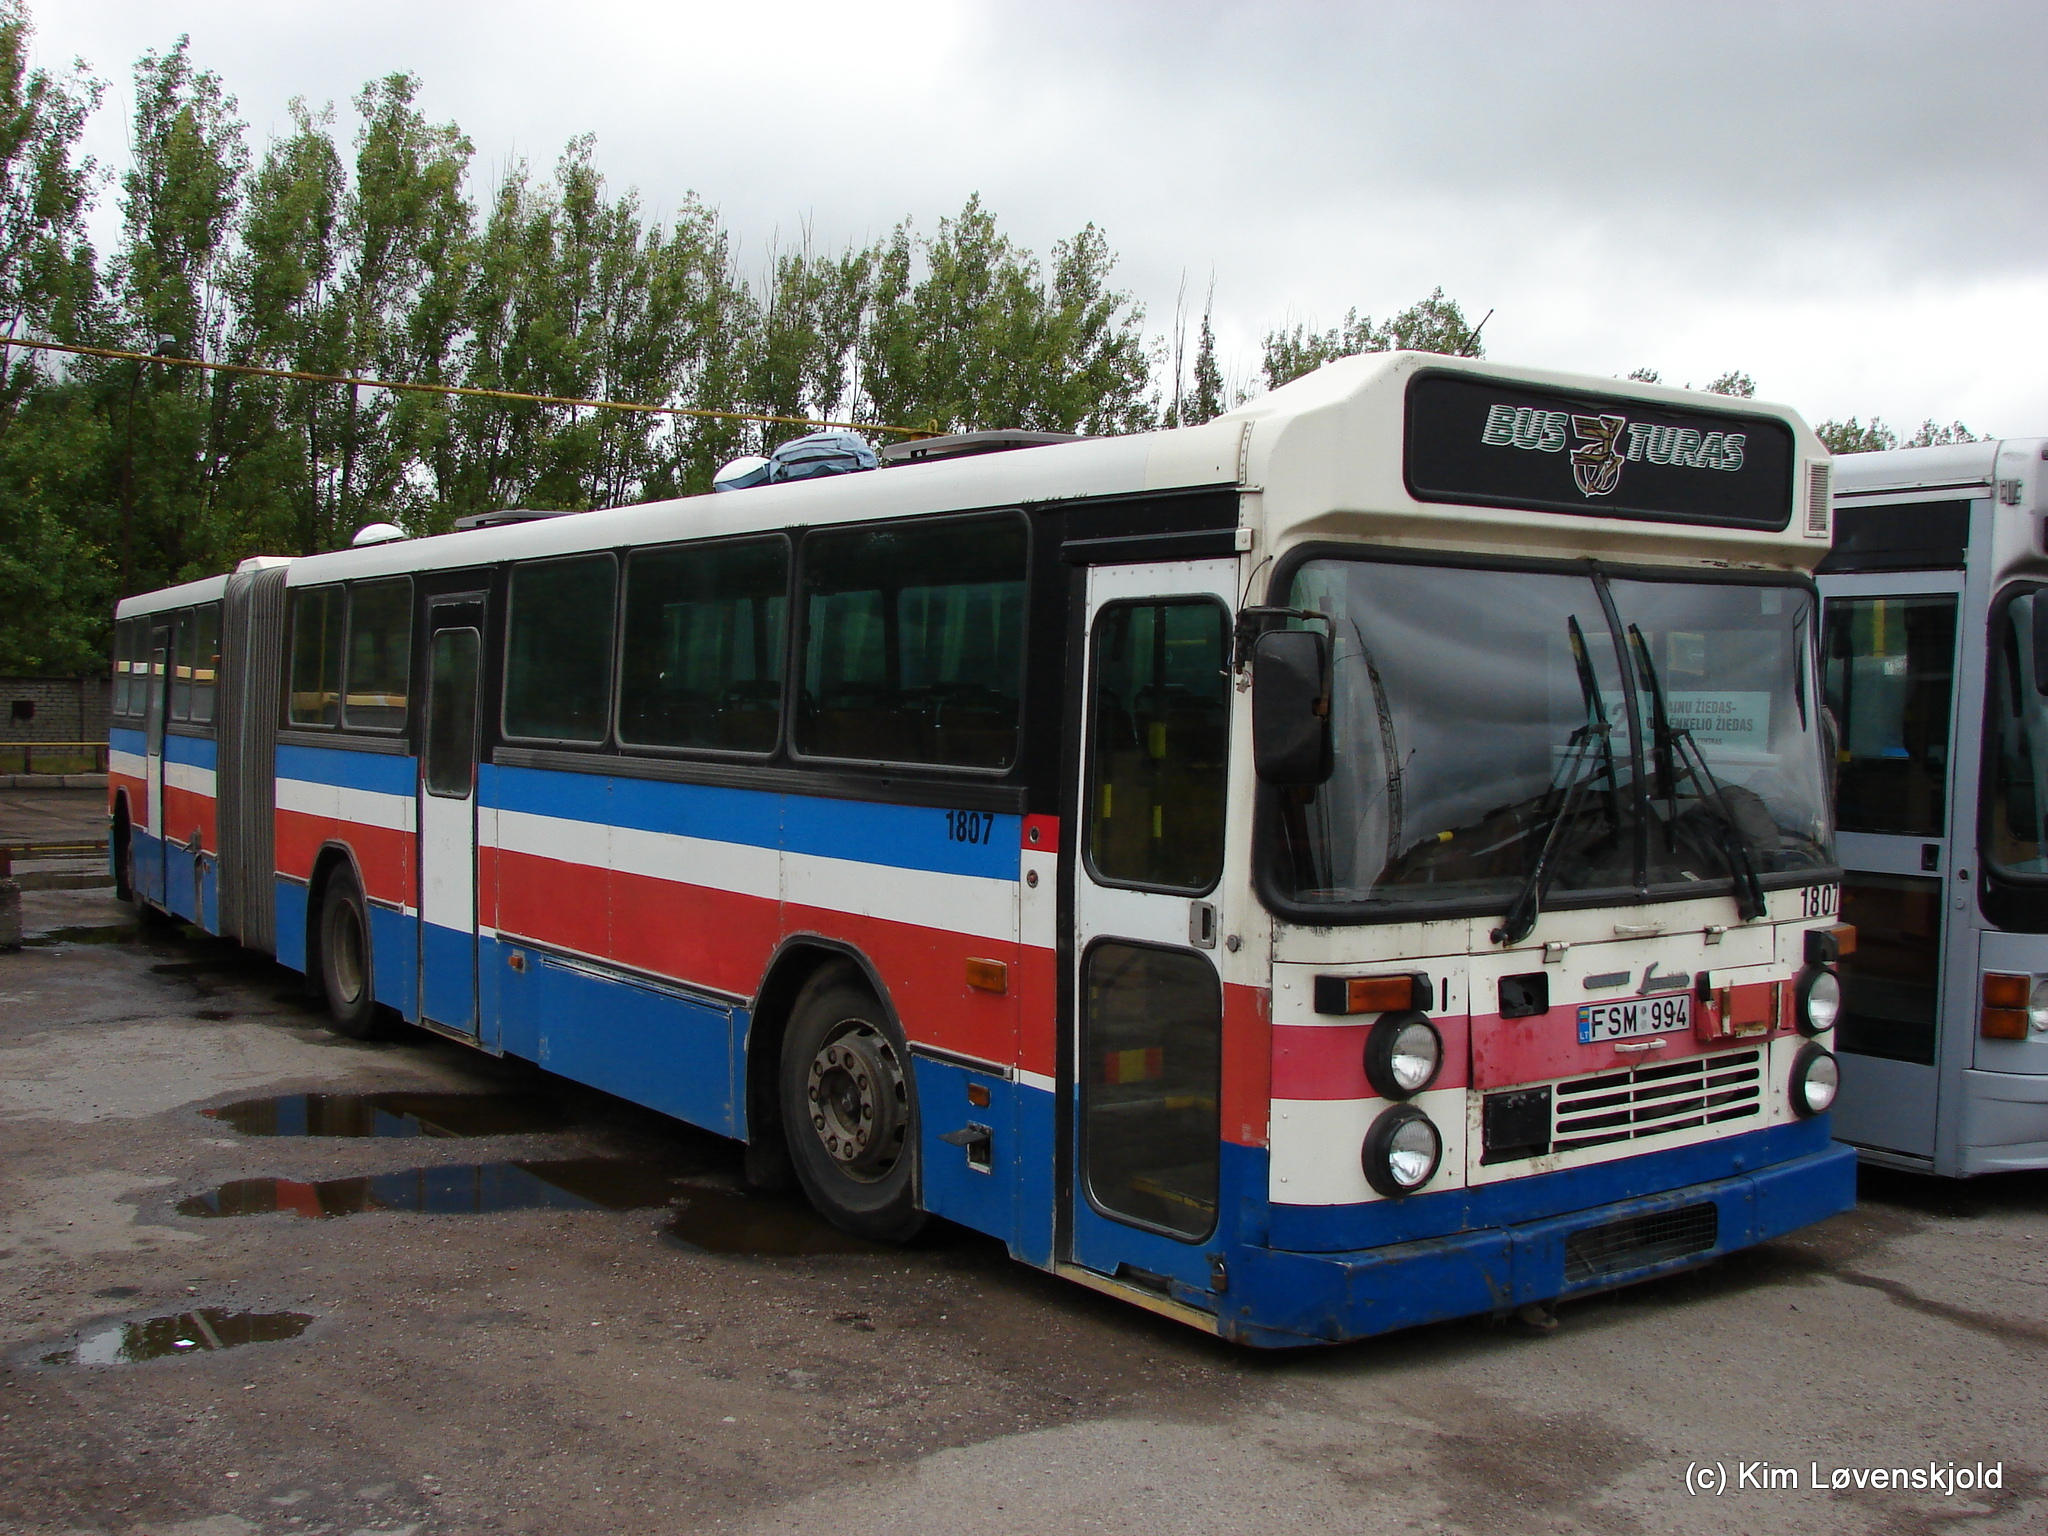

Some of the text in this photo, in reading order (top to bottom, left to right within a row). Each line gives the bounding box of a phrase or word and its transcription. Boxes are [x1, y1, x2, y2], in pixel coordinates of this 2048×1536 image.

[1481, 404, 1746, 472] BUS TURAS
[1715, 715, 1753, 732] ŽIEDAS
[946, 810, 994, 845] 1807
[1801, 882, 1840, 917] 1807
[1579, 1030, 1589, 1041] LT
[1591, 999, 1687, 1038] FSM 994
